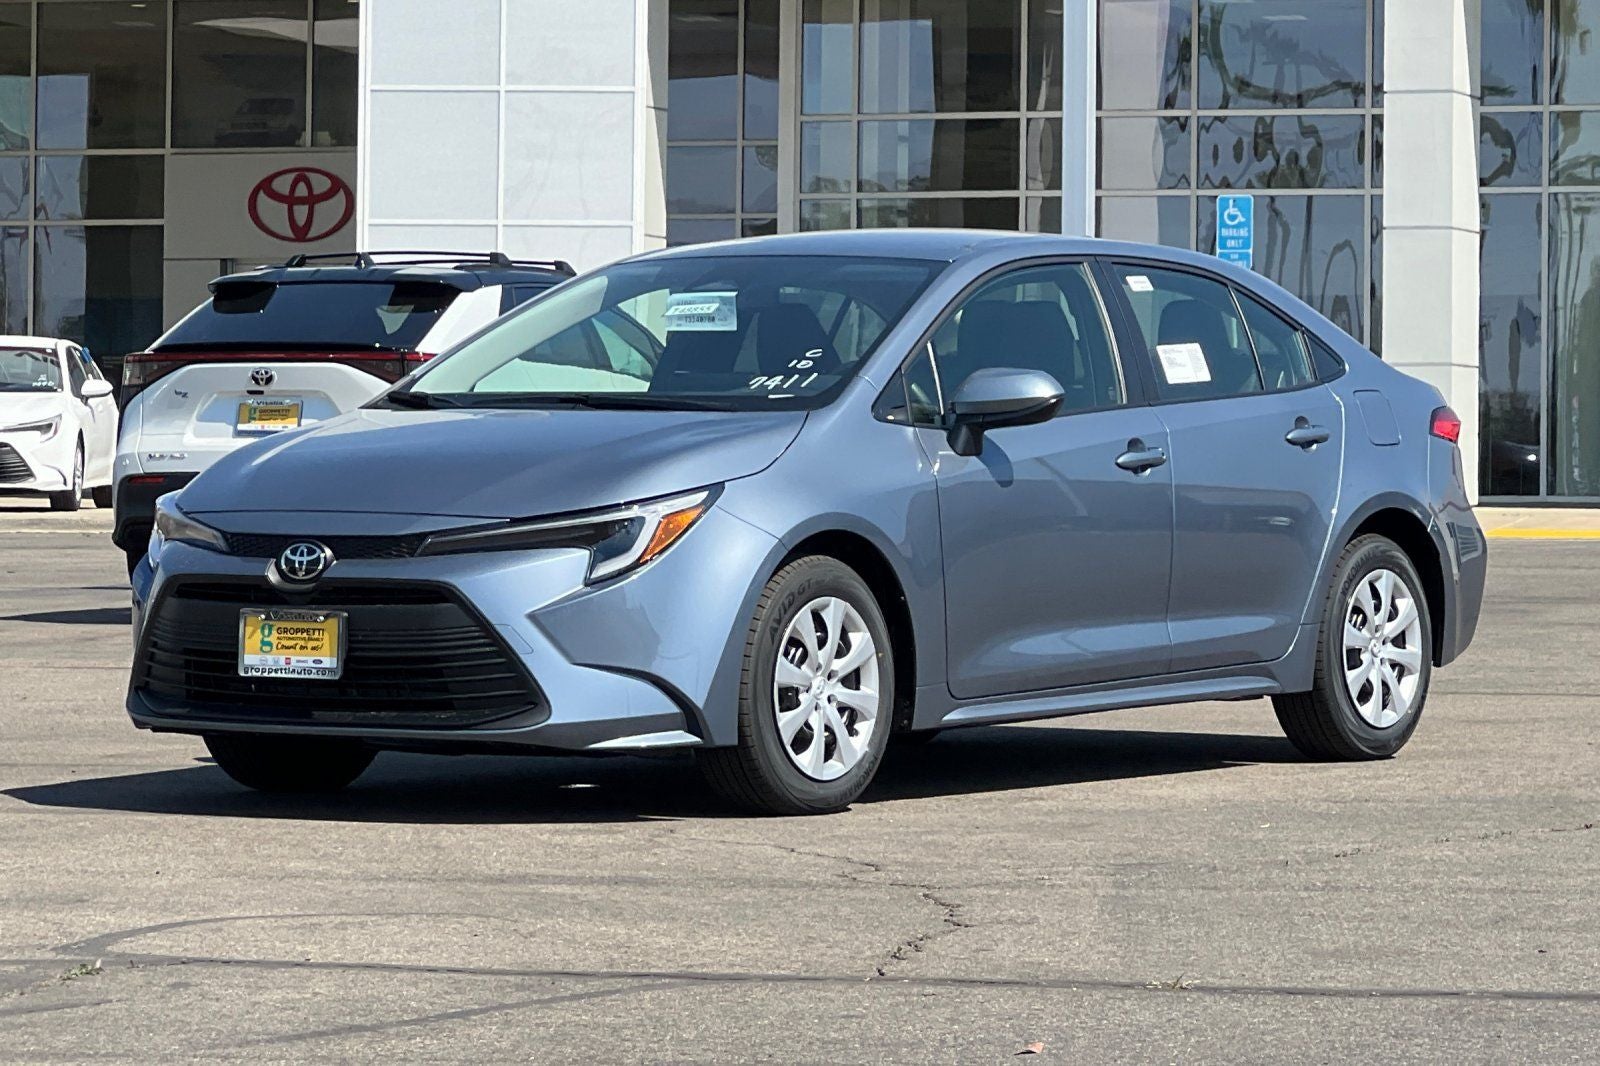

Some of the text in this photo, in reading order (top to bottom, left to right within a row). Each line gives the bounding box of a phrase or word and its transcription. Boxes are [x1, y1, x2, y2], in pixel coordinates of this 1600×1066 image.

[1226, 239, 1244, 248] ONLY
[276, 626, 325, 637] GROPPETTI
[275, 642, 299, 651] Count
[243, 666, 337, 677] groppettiauto.com
